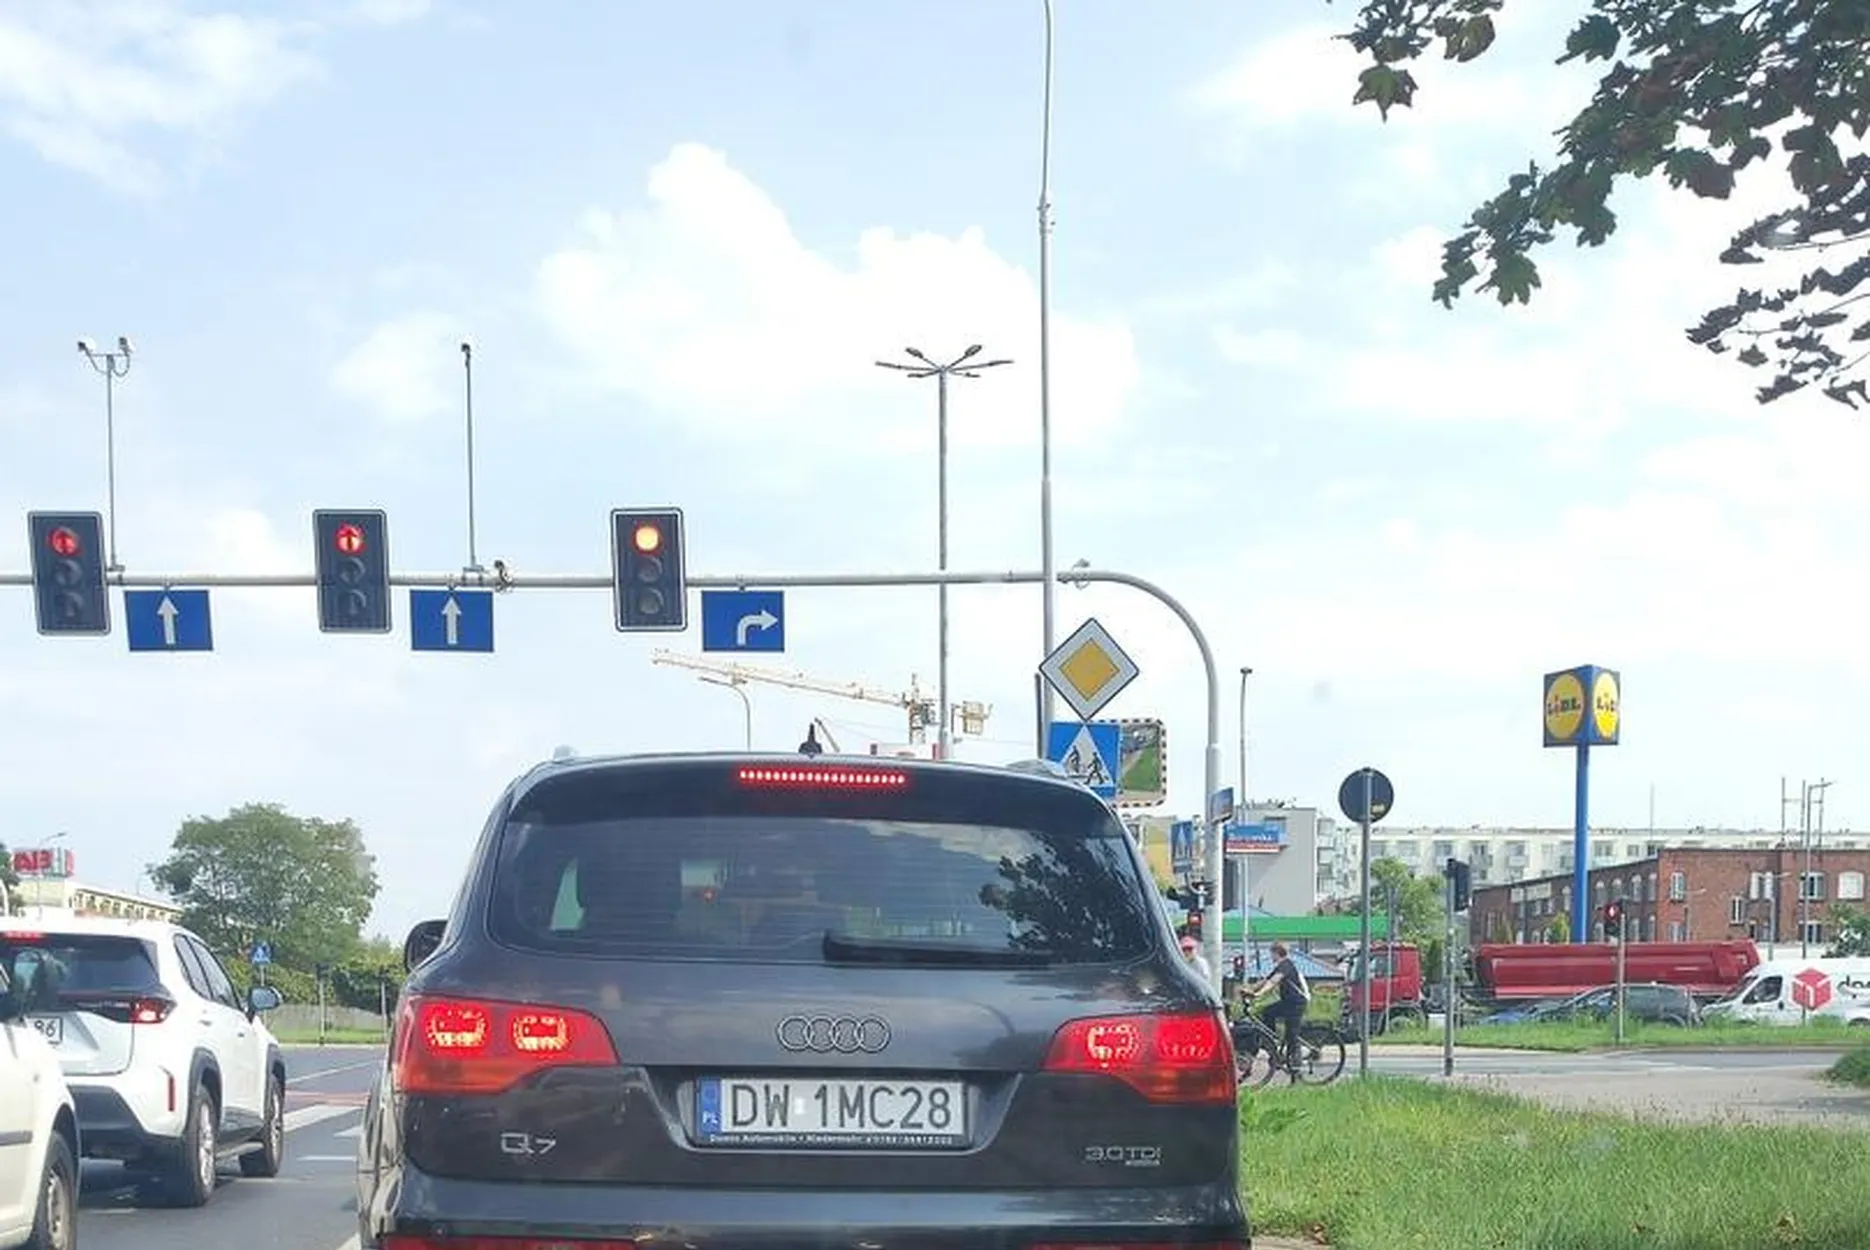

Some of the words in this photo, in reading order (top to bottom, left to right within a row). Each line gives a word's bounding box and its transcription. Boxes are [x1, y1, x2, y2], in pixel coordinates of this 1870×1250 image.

[731, 1083, 789, 1128] DW
[813, 1084, 953, 1130] 1MC28
[500, 1132, 557, 1154] Q7
